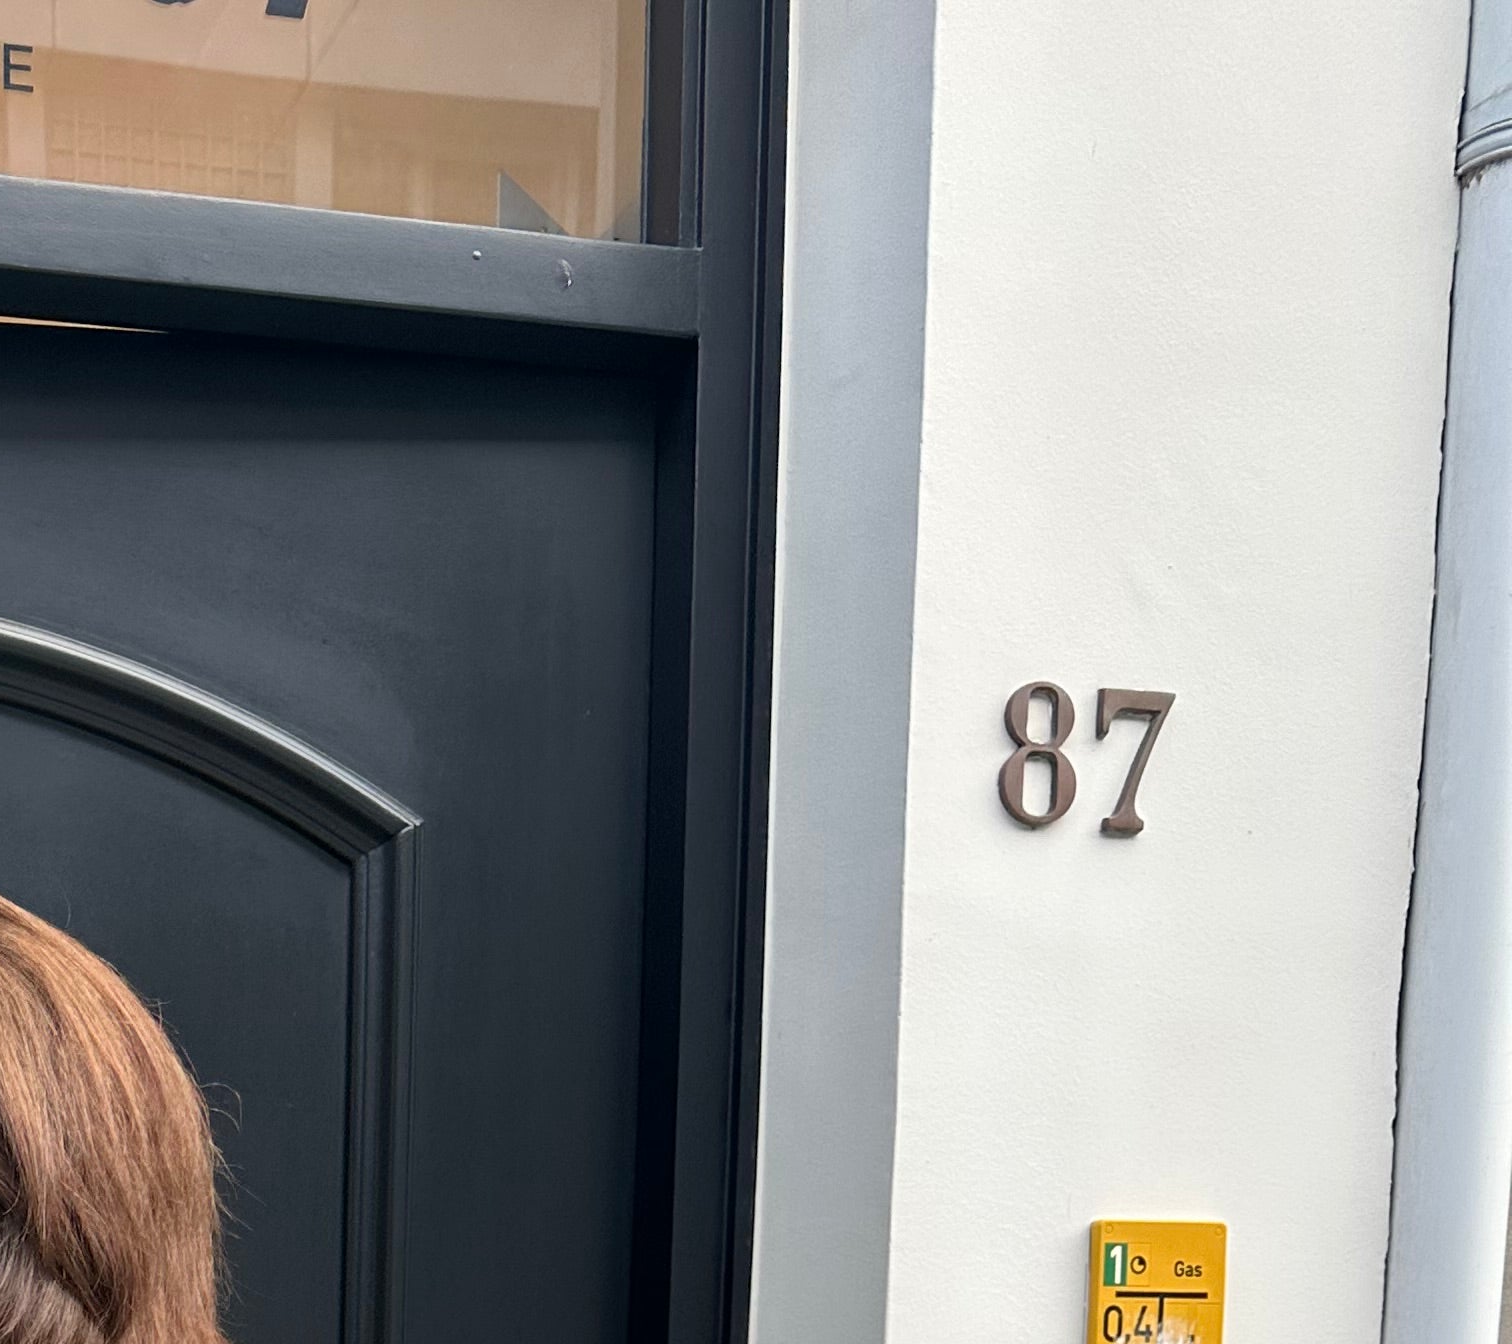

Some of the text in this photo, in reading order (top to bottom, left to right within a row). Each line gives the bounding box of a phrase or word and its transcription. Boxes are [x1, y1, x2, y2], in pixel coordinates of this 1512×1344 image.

[998, 681, 1176, 836] 87
[1110, 1245, 1123, 1284] 1
[1174, 1260, 1203, 1278] Gas
[1103, 1305, 1153, 1343] 0,4
